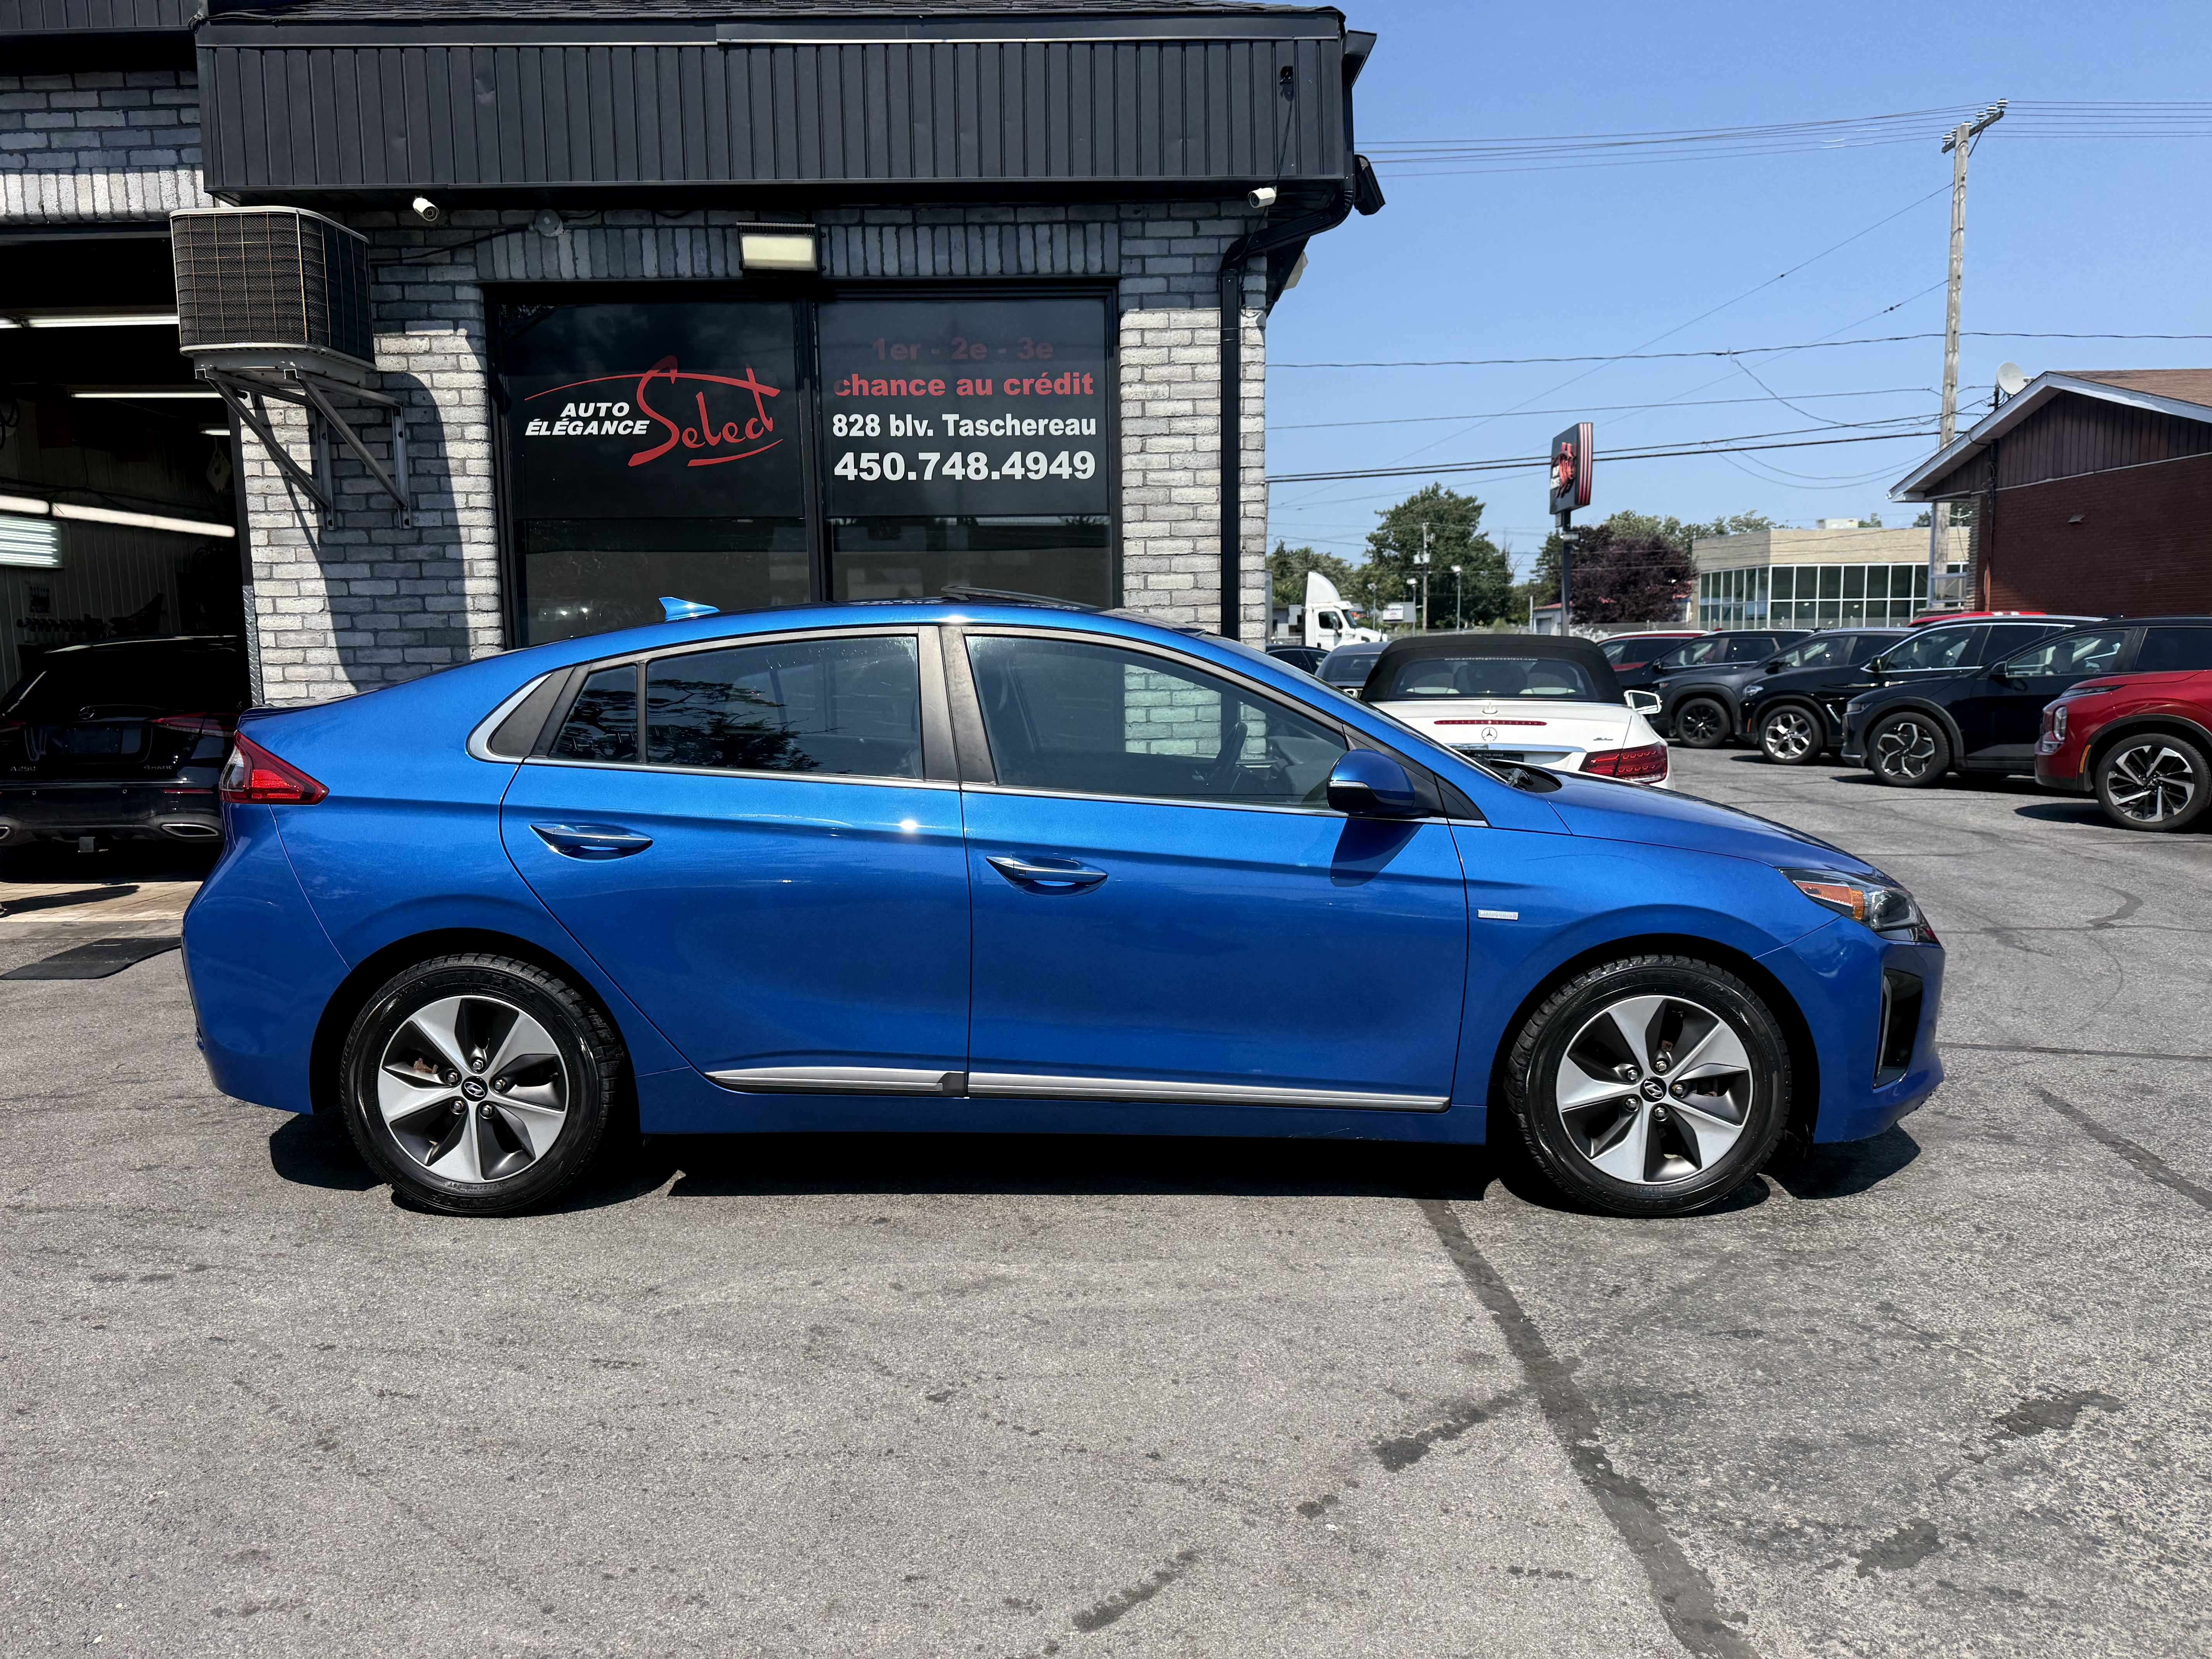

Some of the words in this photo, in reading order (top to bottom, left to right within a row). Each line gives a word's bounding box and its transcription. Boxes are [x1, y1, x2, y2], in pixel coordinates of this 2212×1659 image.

[872, 337, 921, 361] 1er
[951, 337, 988, 361] 2e
[1017, 337, 1054, 360] 3e
[833, 373, 946, 397] chance
[956, 378, 993, 396] au
[1003, 372, 1094, 396] crédit
[560, 402, 630, 417] AUTO
[628, 355, 781, 467] Select
[525, 418, 651, 436] ÉLÉGANCE
[833, 414, 881, 437] 828
[889, 414, 934, 437] blv.
[942, 413, 1096, 437] Taschereau
[834, 450, 1096, 481] 450.748.4949
